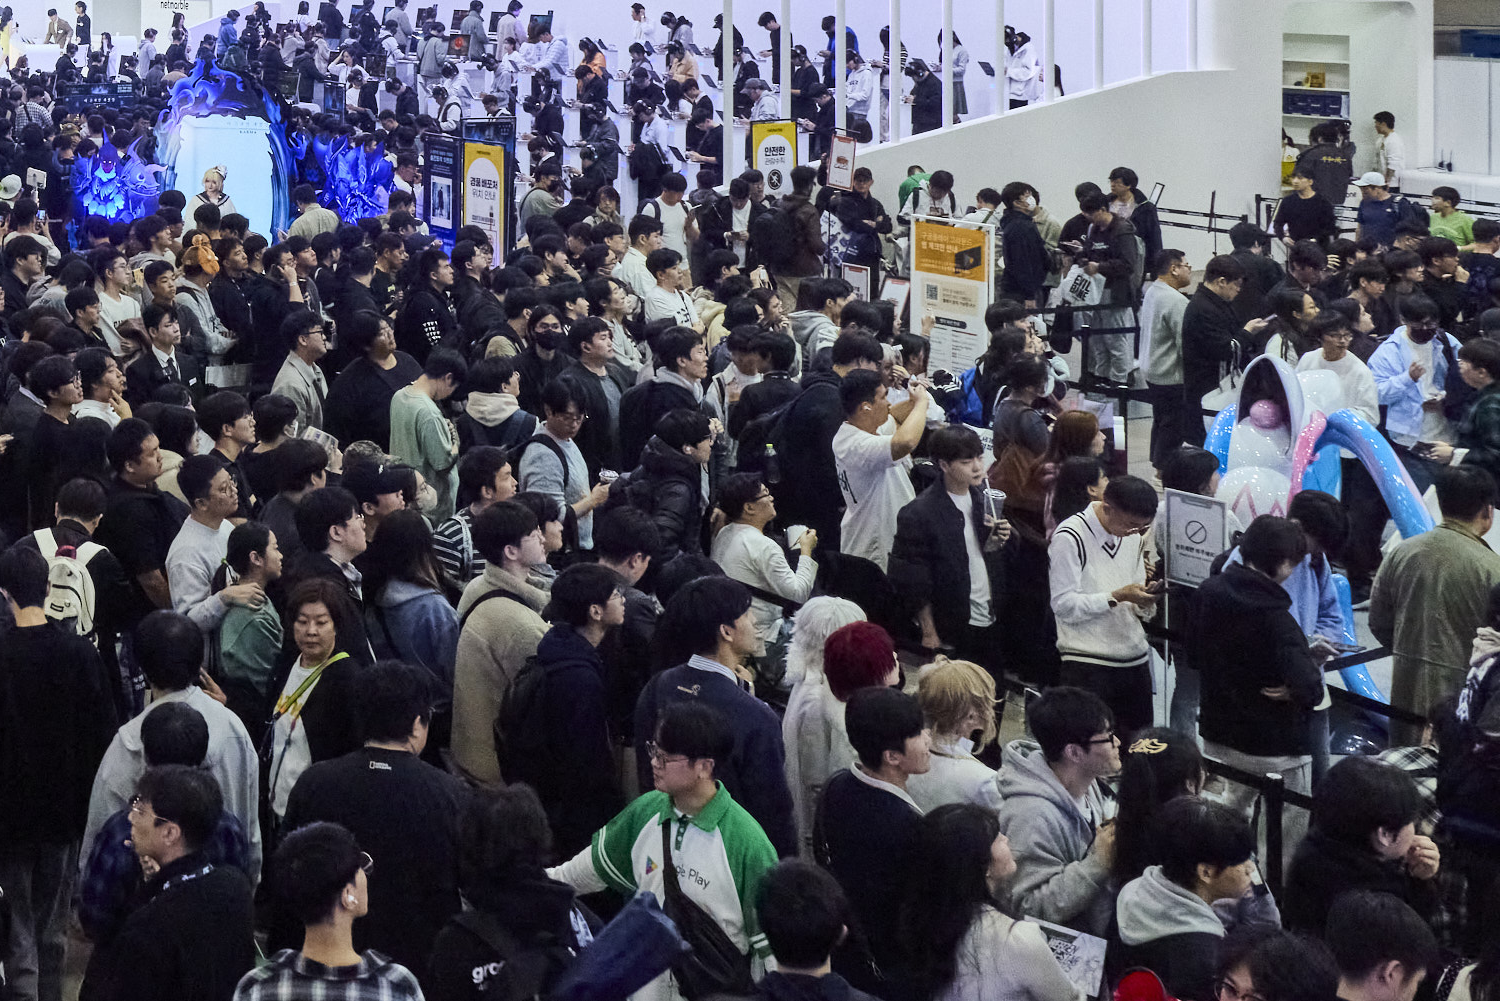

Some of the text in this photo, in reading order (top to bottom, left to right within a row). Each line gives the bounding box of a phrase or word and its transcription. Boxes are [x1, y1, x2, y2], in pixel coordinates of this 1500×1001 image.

[160, 0, 189, 10] netmarble
[764, 145, 786, 157] 안전한
[688, 868, 710, 890] Play
